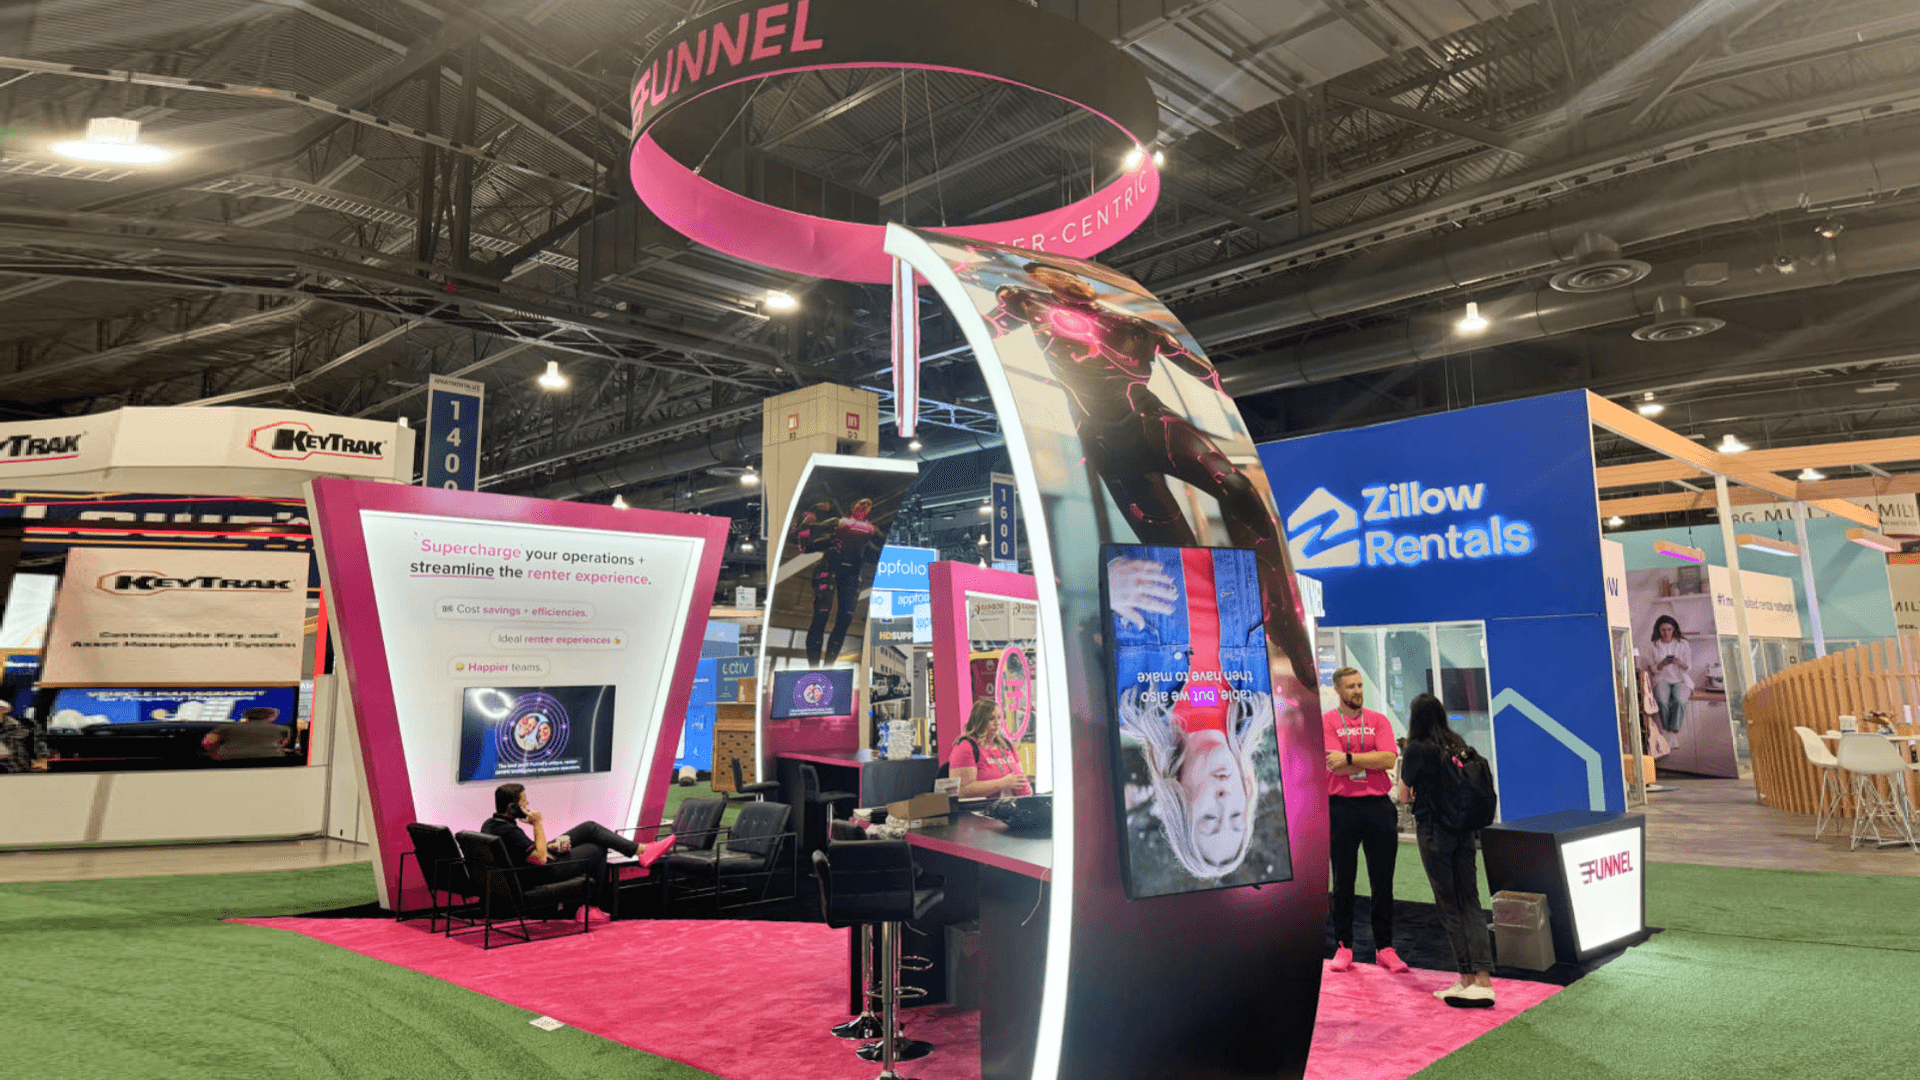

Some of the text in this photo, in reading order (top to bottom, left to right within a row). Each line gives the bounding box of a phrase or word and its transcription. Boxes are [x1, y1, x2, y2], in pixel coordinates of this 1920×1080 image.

[632, 0, 823, 138] FUNNEL
[1362, 481, 1484, 521] Zillow
[1365, 515, 1530, 566] Rentals
[421, 539, 521, 560] Supercharge
[525, 548, 558, 561] your
[562, 551, 635, 565] operations
[410, 561, 652, 585] streamline the renter experience.
[456, 604, 480, 614] Cost
[483, 606, 520, 616] savings
[532, 607, 587, 617] efficiencies.
[498, 634, 611, 645] Ideal renter experiences
[468, 663, 542, 674] Happier teams.
[1137, 671, 1253, 683] then have to make
[1140, 691, 1169, 702] also
[1171, 691, 1190, 701] we
[1192, 690, 1215, 702] but
[1578, 850, 1633, 884] FUNNEL
